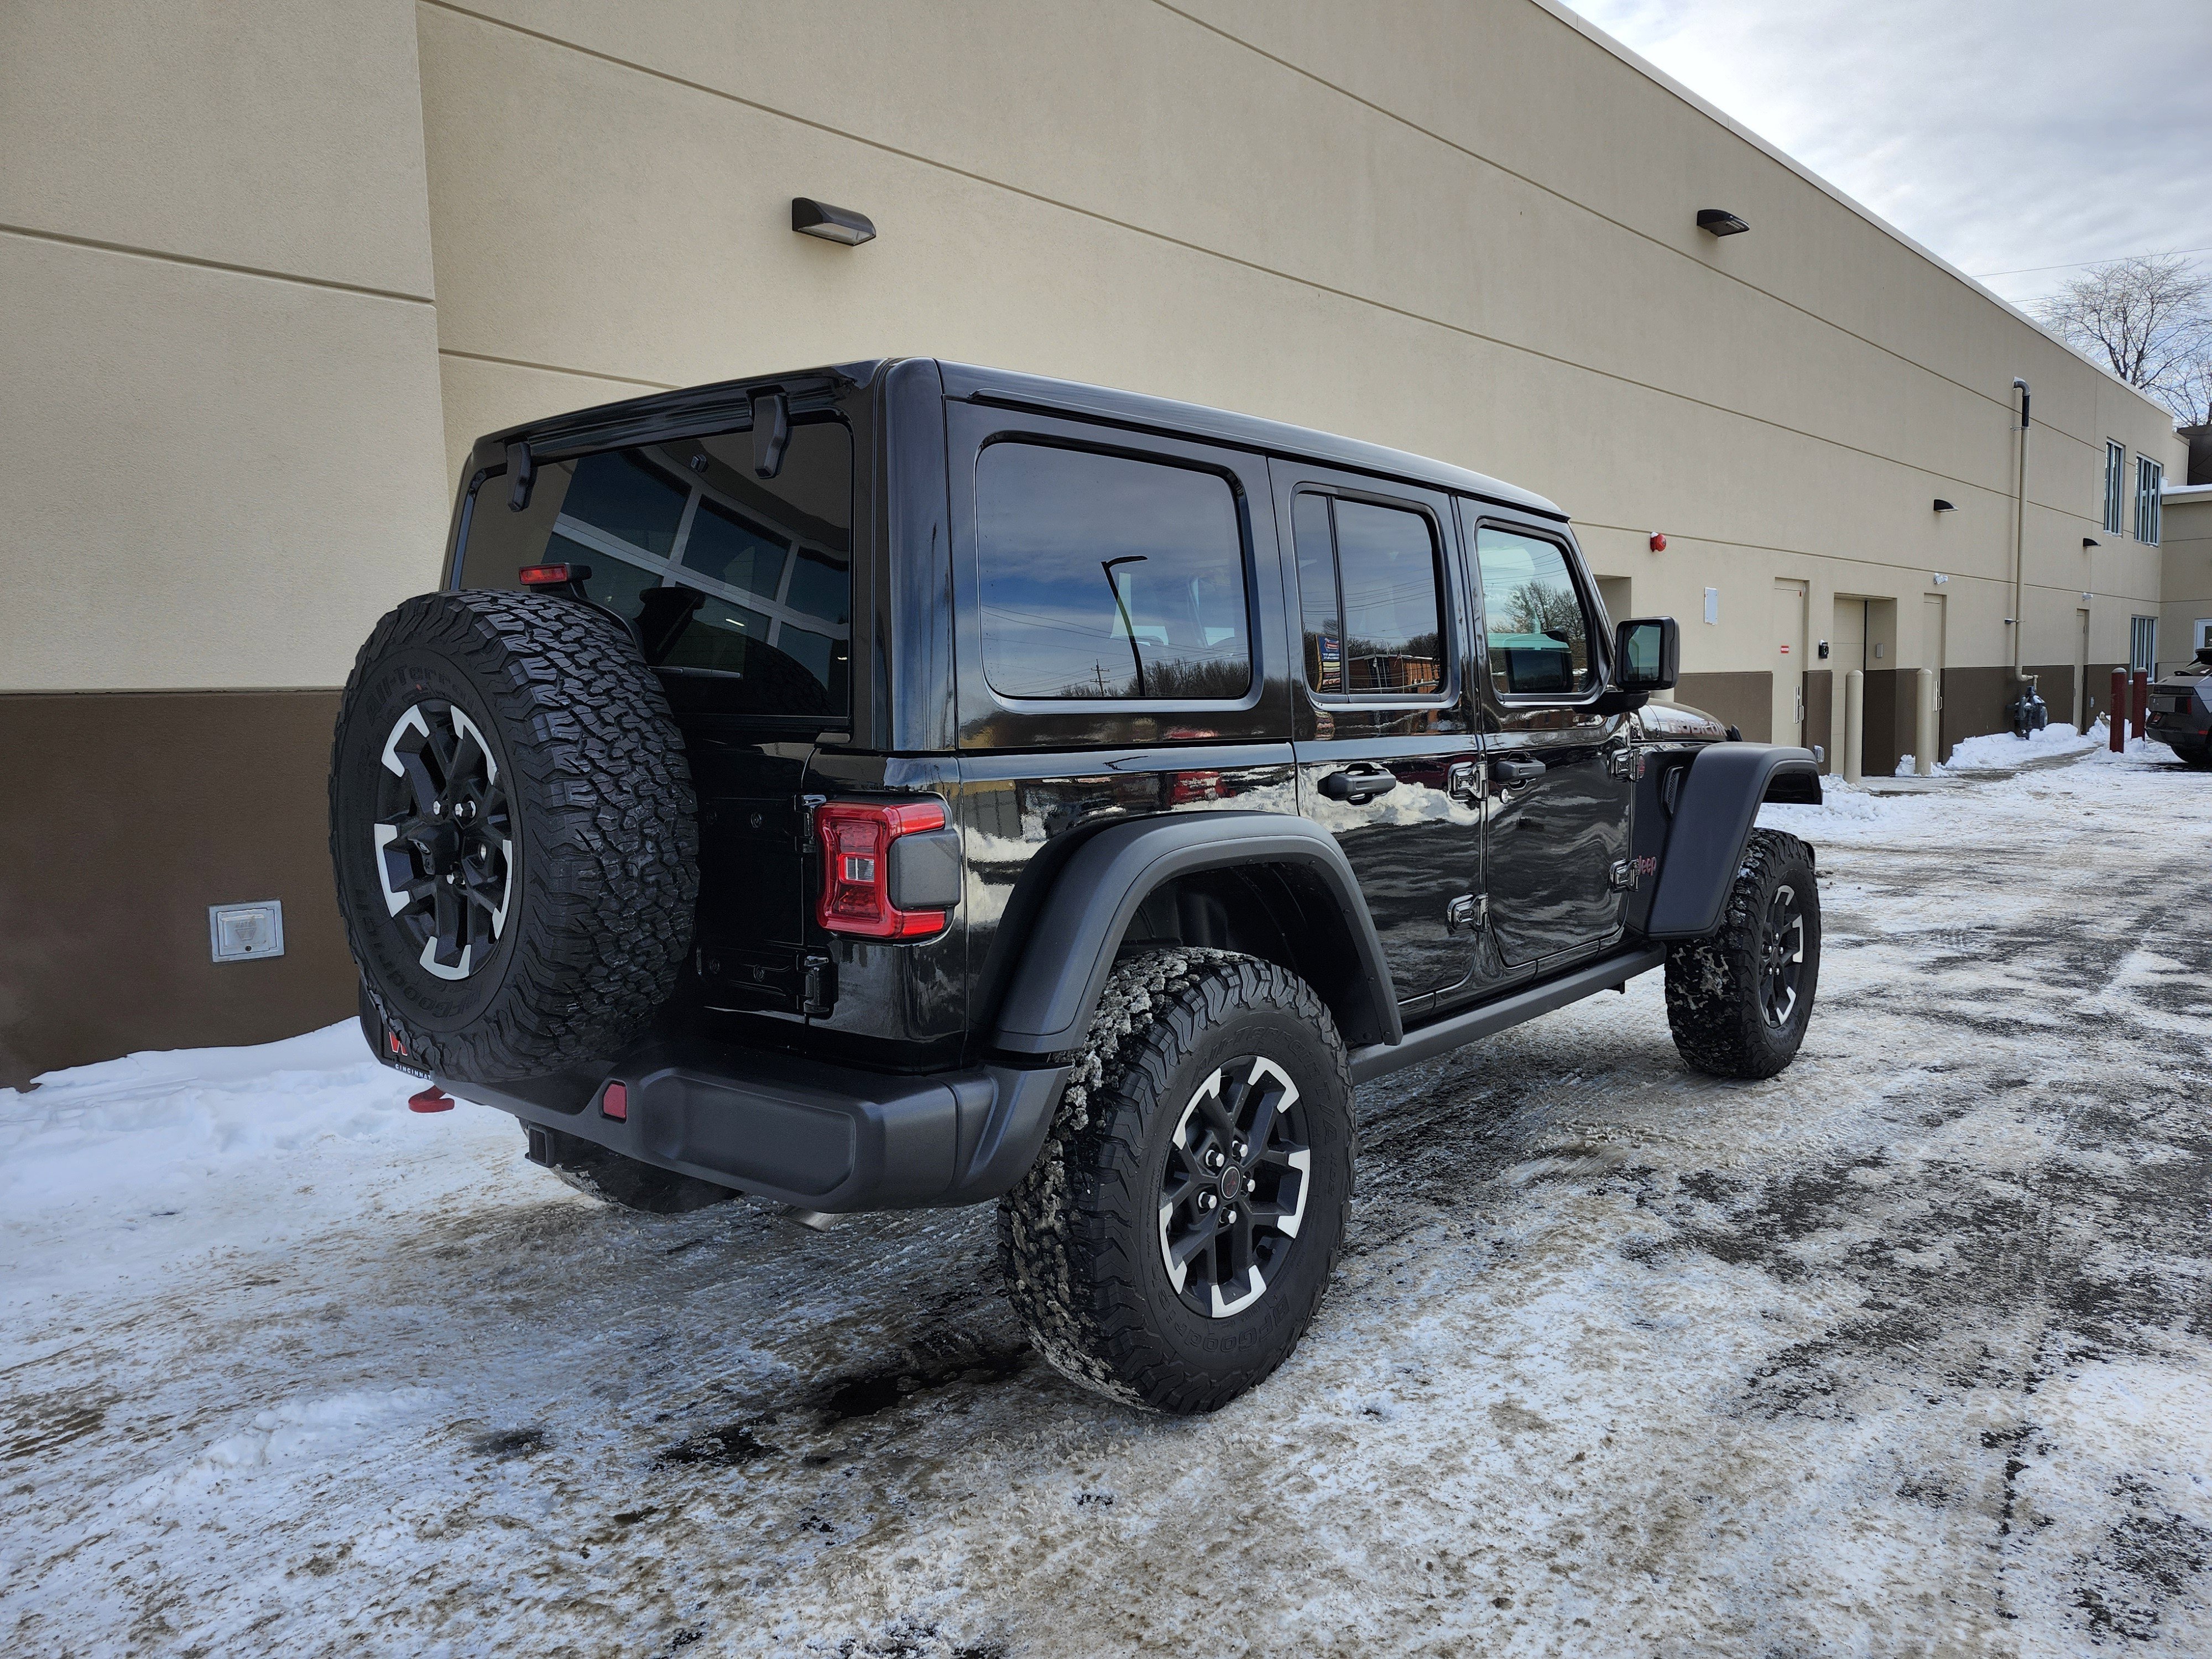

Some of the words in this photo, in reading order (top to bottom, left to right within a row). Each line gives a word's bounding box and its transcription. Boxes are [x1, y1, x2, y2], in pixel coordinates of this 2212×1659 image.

[1667, 718, 1728, 738] RUBICON
[1637, 855, 1657, 877] Jeep
[1151, 1263, 1291, 1353] BFGoodrich
